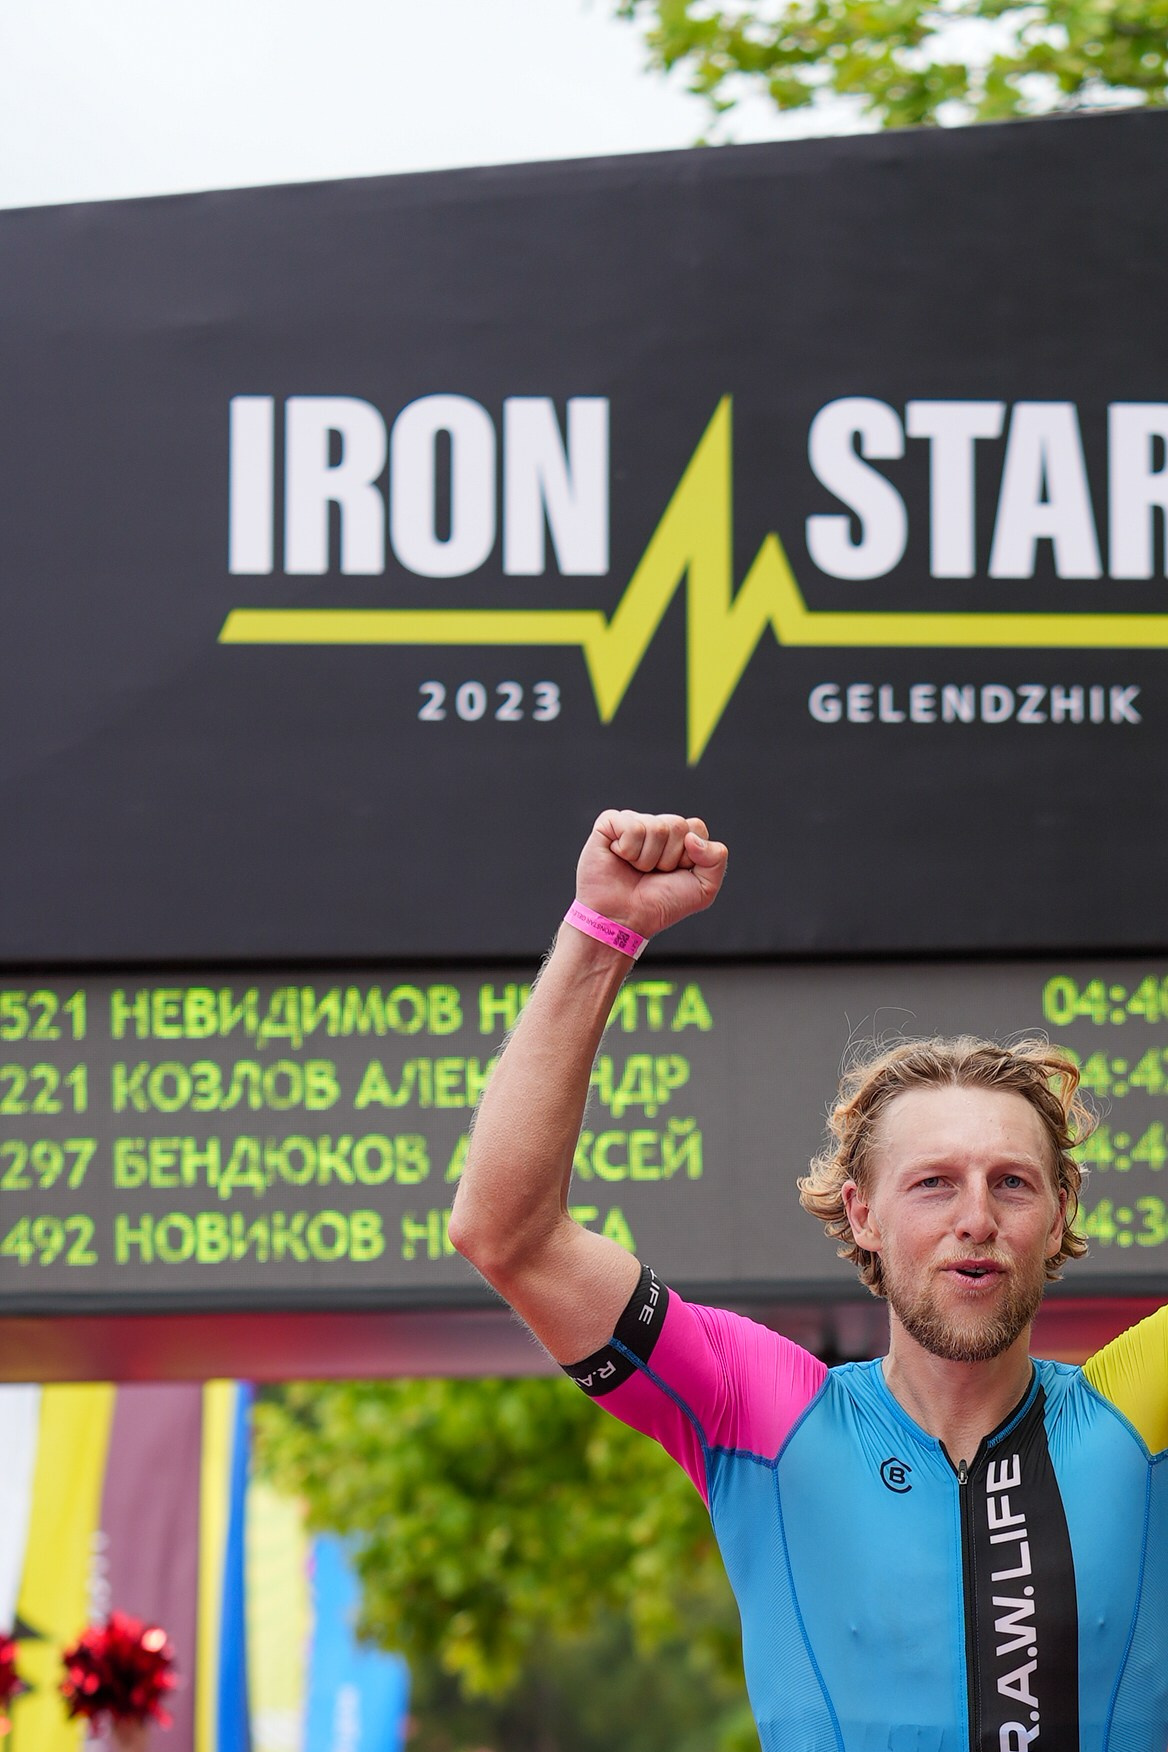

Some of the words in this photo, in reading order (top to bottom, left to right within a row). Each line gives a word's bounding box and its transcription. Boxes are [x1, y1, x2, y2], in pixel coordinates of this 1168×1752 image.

[229, 394, 609, 577] IRON
[418, 681, 563, 722] 2023
[808, 682, 1142, 724] GELENDZHIK
[0, 988, 88, 1042] 521
[110, 983, 464, 1051] НЕВИДИМОВ
[0, 1061, 89, 1115] 221
[112, 1058, 341, 1113] КОЗЛОВ
[0, 1136, 99, 1192] 297
[113, 1133, 431, 1200] БЕНДЮКОВ
[0, 1213, 99, 1267] 492
[115, 1210, 387, 1265] НОВИКОВ
